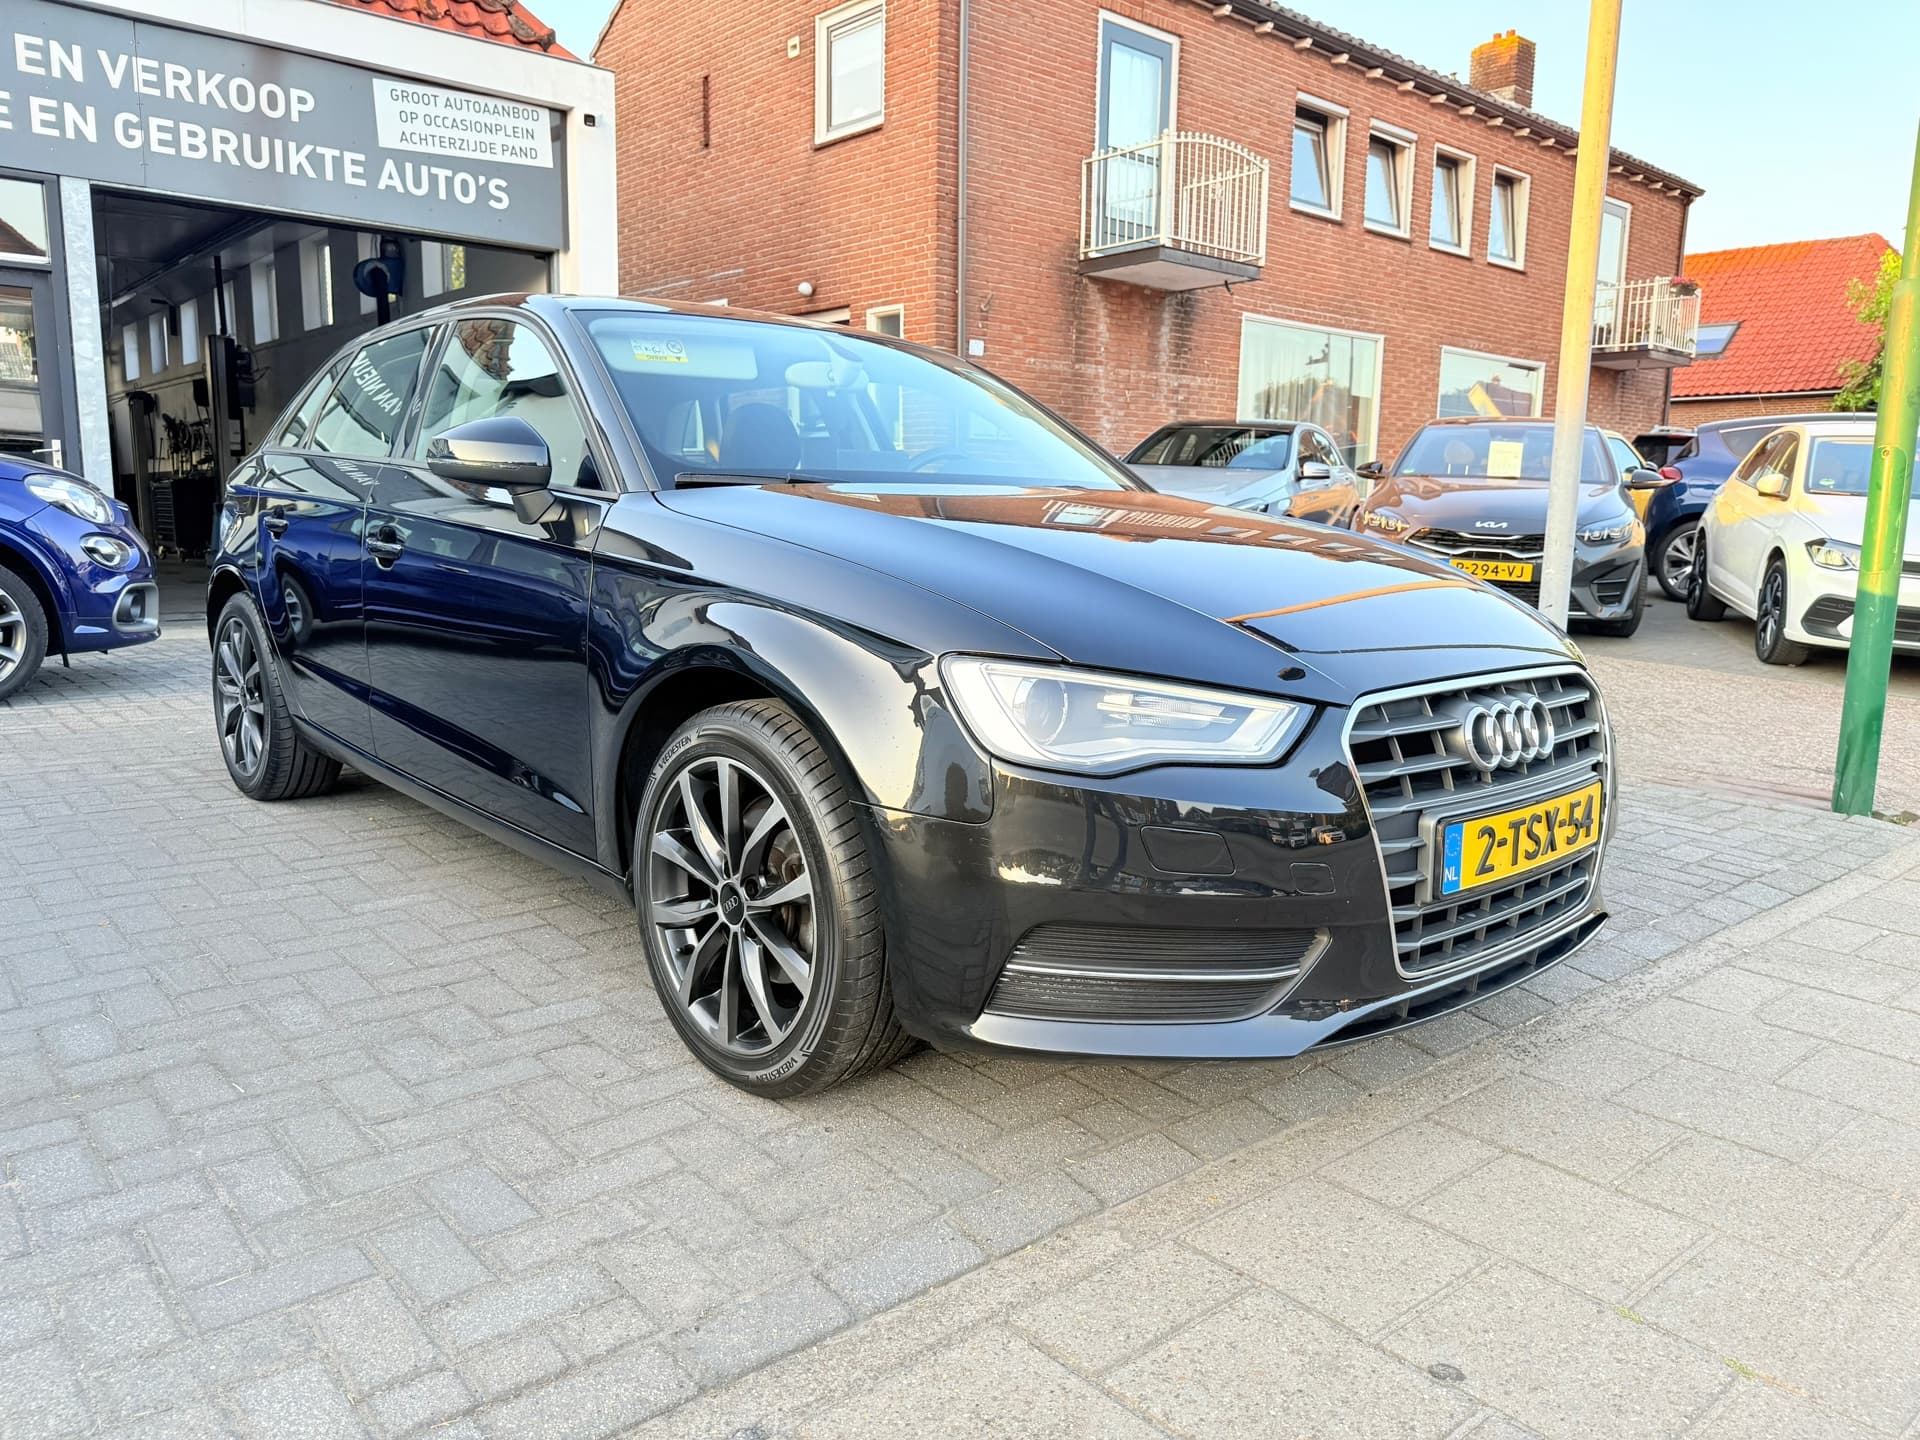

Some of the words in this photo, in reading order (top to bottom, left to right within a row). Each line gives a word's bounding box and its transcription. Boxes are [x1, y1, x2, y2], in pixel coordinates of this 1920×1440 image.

[14, 32, 84, 83] EN
[97, 49, 315, 123] VERKOOP
[390, 88, 440, 108] GROOT
[444, 96, 540, 122] AUTOAANBOD
[29, 95, 98, 143] EN
[114, 111, 367, 188] GEBRUIKTE
[377, 158, 510, 210] AUTO'S
[399, 110, 419, 125] OP
[423, 113, 536, 141] OCCASIONPLEIN
[399, 130, 498, 155] ACHTERZIJDE
[501, 144, 538, 161] PAND
[1444, 866, 1459, 883] NL
[1475, 793, 1595, 877] 2-TSX-54
